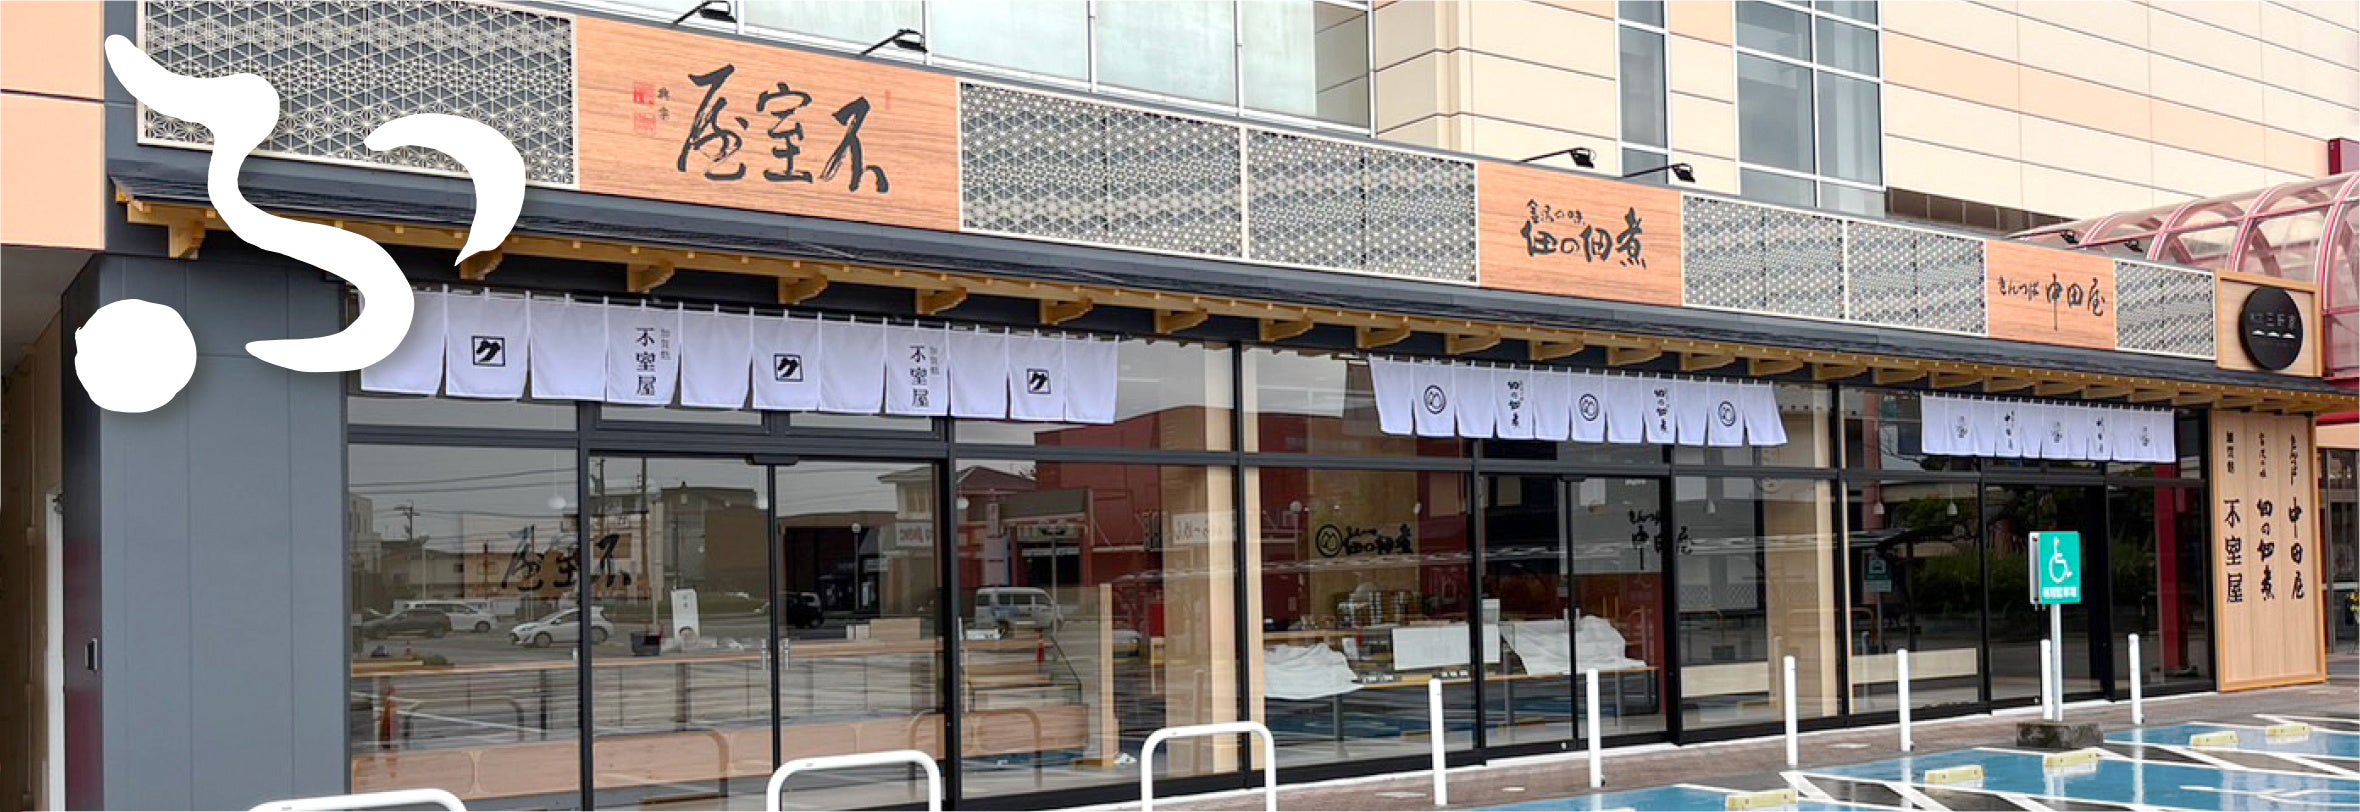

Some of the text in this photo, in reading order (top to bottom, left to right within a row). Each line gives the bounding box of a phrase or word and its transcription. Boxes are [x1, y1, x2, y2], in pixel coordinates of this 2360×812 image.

[1520, 207, 1647, 270] 佃の佃煮
[2044, 273, 2105, 331] 中田屋
[636, 327, 656, 396] 不室屋
[909, 345, 929, 408] 不室屋
[2223, 498, 2243, 603] 不室屋
[2288, 496, 2304, 600] 中田屋
